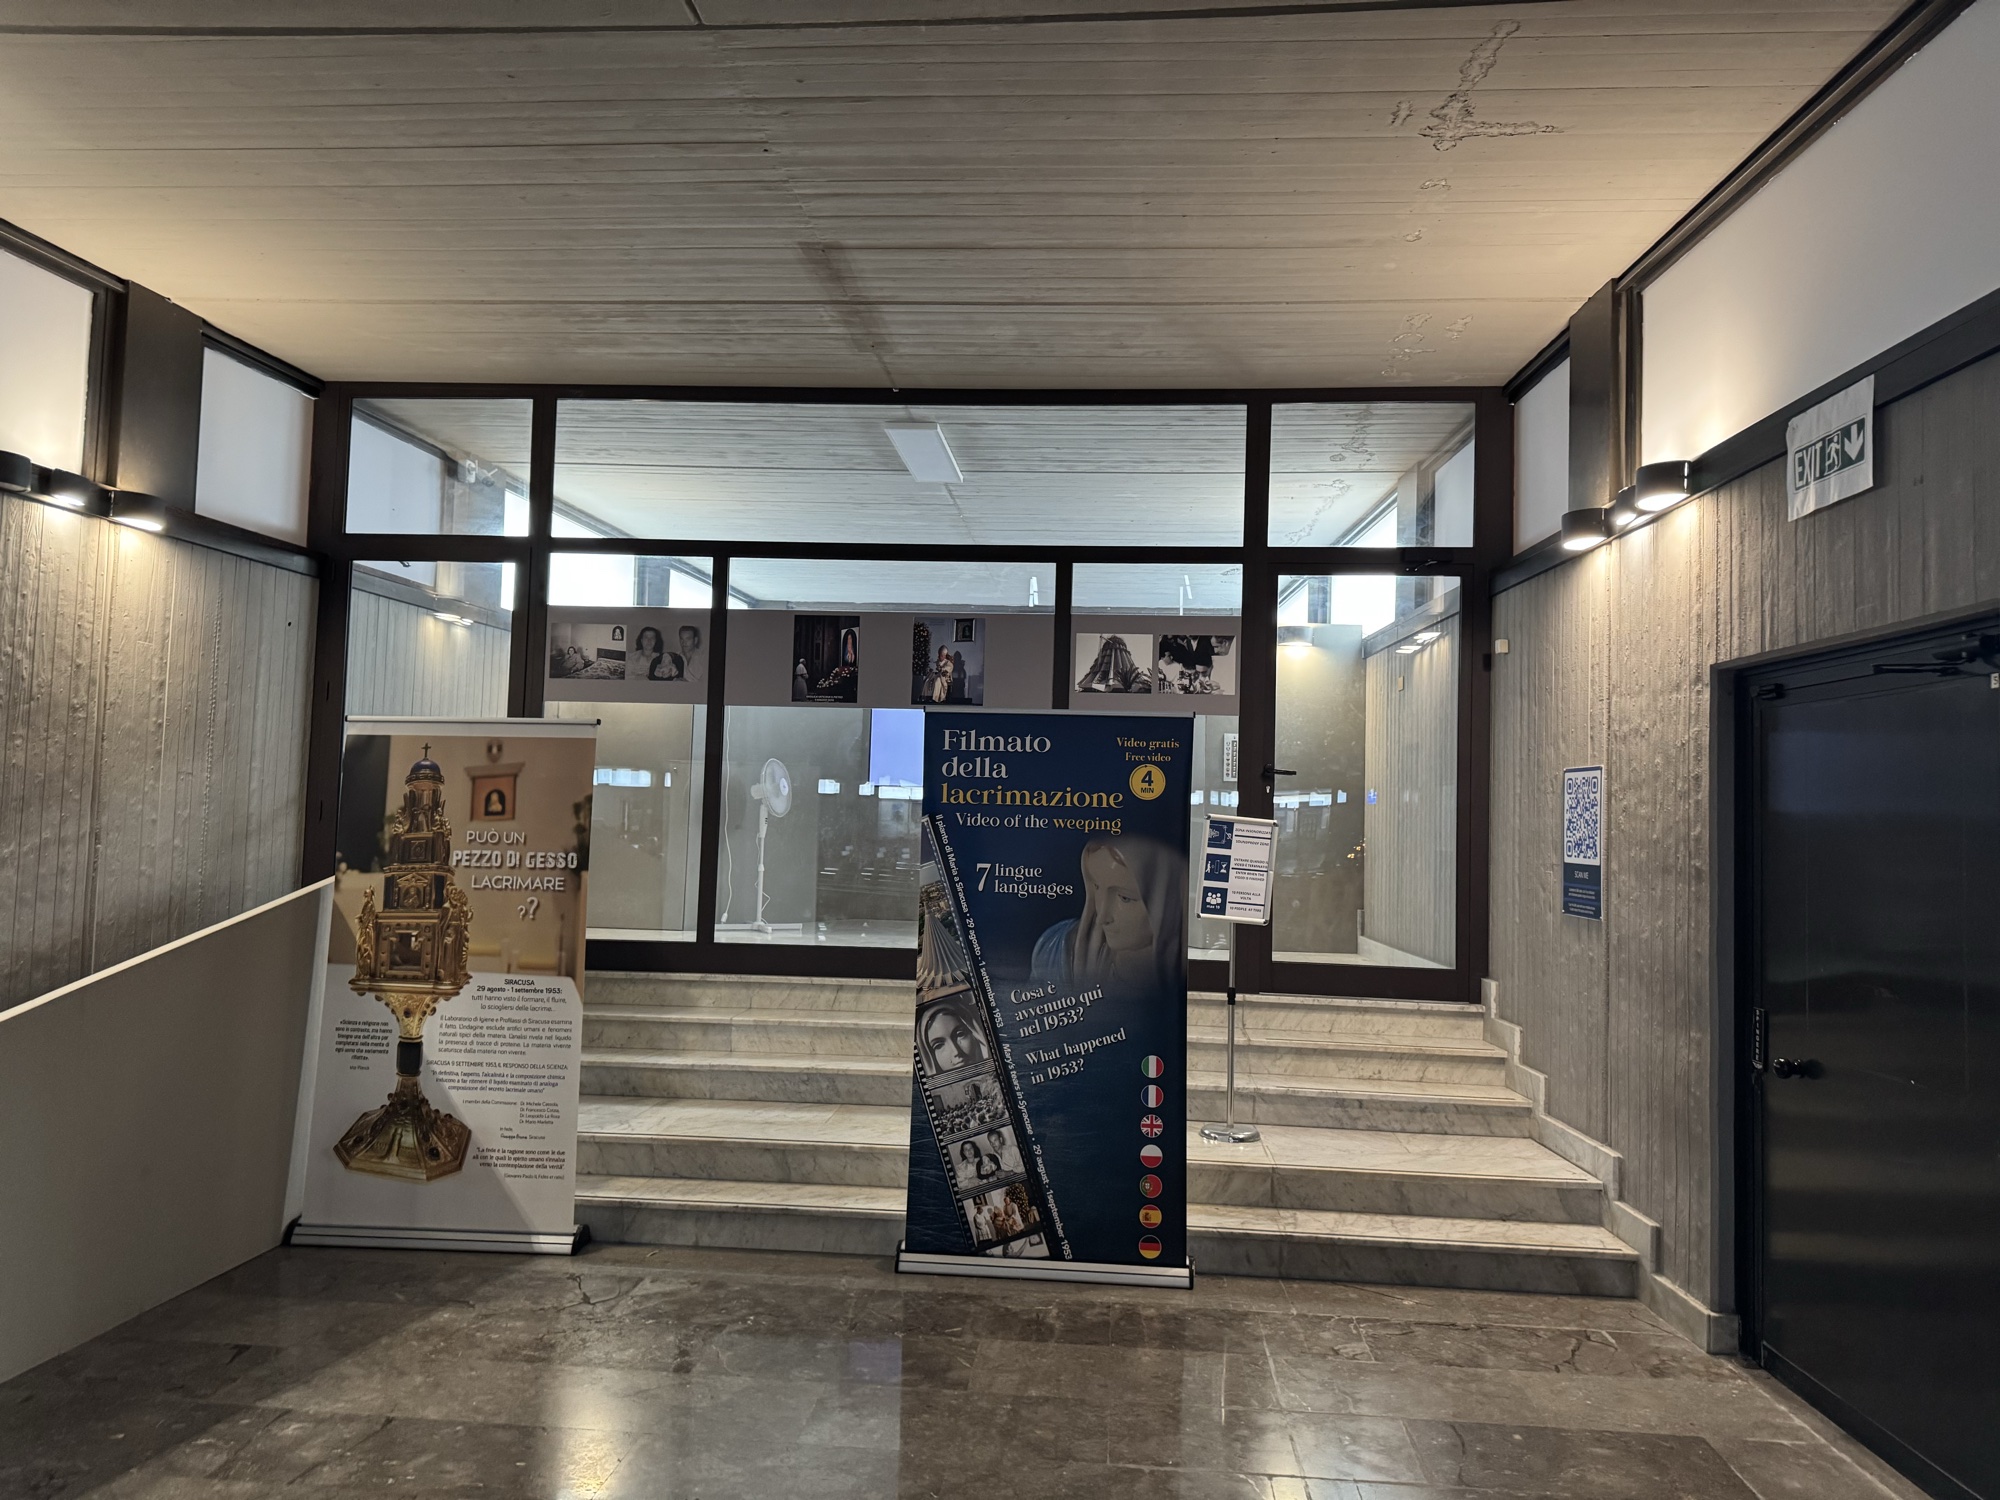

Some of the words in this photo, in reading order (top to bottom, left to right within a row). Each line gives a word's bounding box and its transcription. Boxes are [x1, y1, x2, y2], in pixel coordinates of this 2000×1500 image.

[1796, 441, 1823, 488] EXIT
[943, 729, 1051, 753] Filmato
[1116, 737, 1146, 748] Video
[1149, 738, 1180, 751] gratis
[942, 757, 1008, 778] della
[1125, 752, 1145, 762] Free
[1147, 753, 1170, 762] video
[1141, 770, 1153, 786] 4
[941, 783, 1123, 808] lacrimazione
[936, 821, 948, 844] pianto
[956, 812, 1000, 828] Video
[1005, 814, 1021, 828] of
[1024, 814, 1048, 829] the
[1053, 816, 1121, 835] weeping
[466, 828, 499, 843] PUÒ
[504, 832, 525, 844] UN
[452, 850, 501, 867] PEZZO
[506, 850, 520, 867] DI
[526, 851, 578, 868] GESSO
[948, 853, 958, 875] Maria
[472, 875, 564, 890] LACRIMARE
[976, 863, 991, 892] 7
[995, 863, 1042, 881] lingue
[1574, 870, 1583, 878] SCAN
[956, 882, 968, 912] Siracusa
[994, 882, 1073, 899] languages
[966, 918, 974, 927] 29
[969, 930, 980, 955] agosto
[981, 968, 996, 1006] settembre
[1010, 986, 1044, 1004] Cosa
[1047, 981, 1057, 994] è
[1015, 995, 1076, 1021] avvenuto
[1079, 984, 1103, 1006] qui
[992, 1008, 1004, 1028] 1953
[1019, 1017, 1041, 1038] nel
[1044, 1007, 1084, 1031] 1953?
[1003, 1043, 1015, 1069] Mary's
[1025, 1047, 1061, 1065] What
[1063, 1028, 1126, 1056] happened
[1011, 1071, 1020, 1090] tears
[1030, 1072, 1044, 1085] in
[1047, 1058, 1084, 1080] 1953?
[1018, 1100, 1033, 1135] Syracuse
[1033, 1144, 1042, 1155] 29
[1037, 1157, 1050, 1184] august
[1061, 1240, 1072, 1260] 1953
